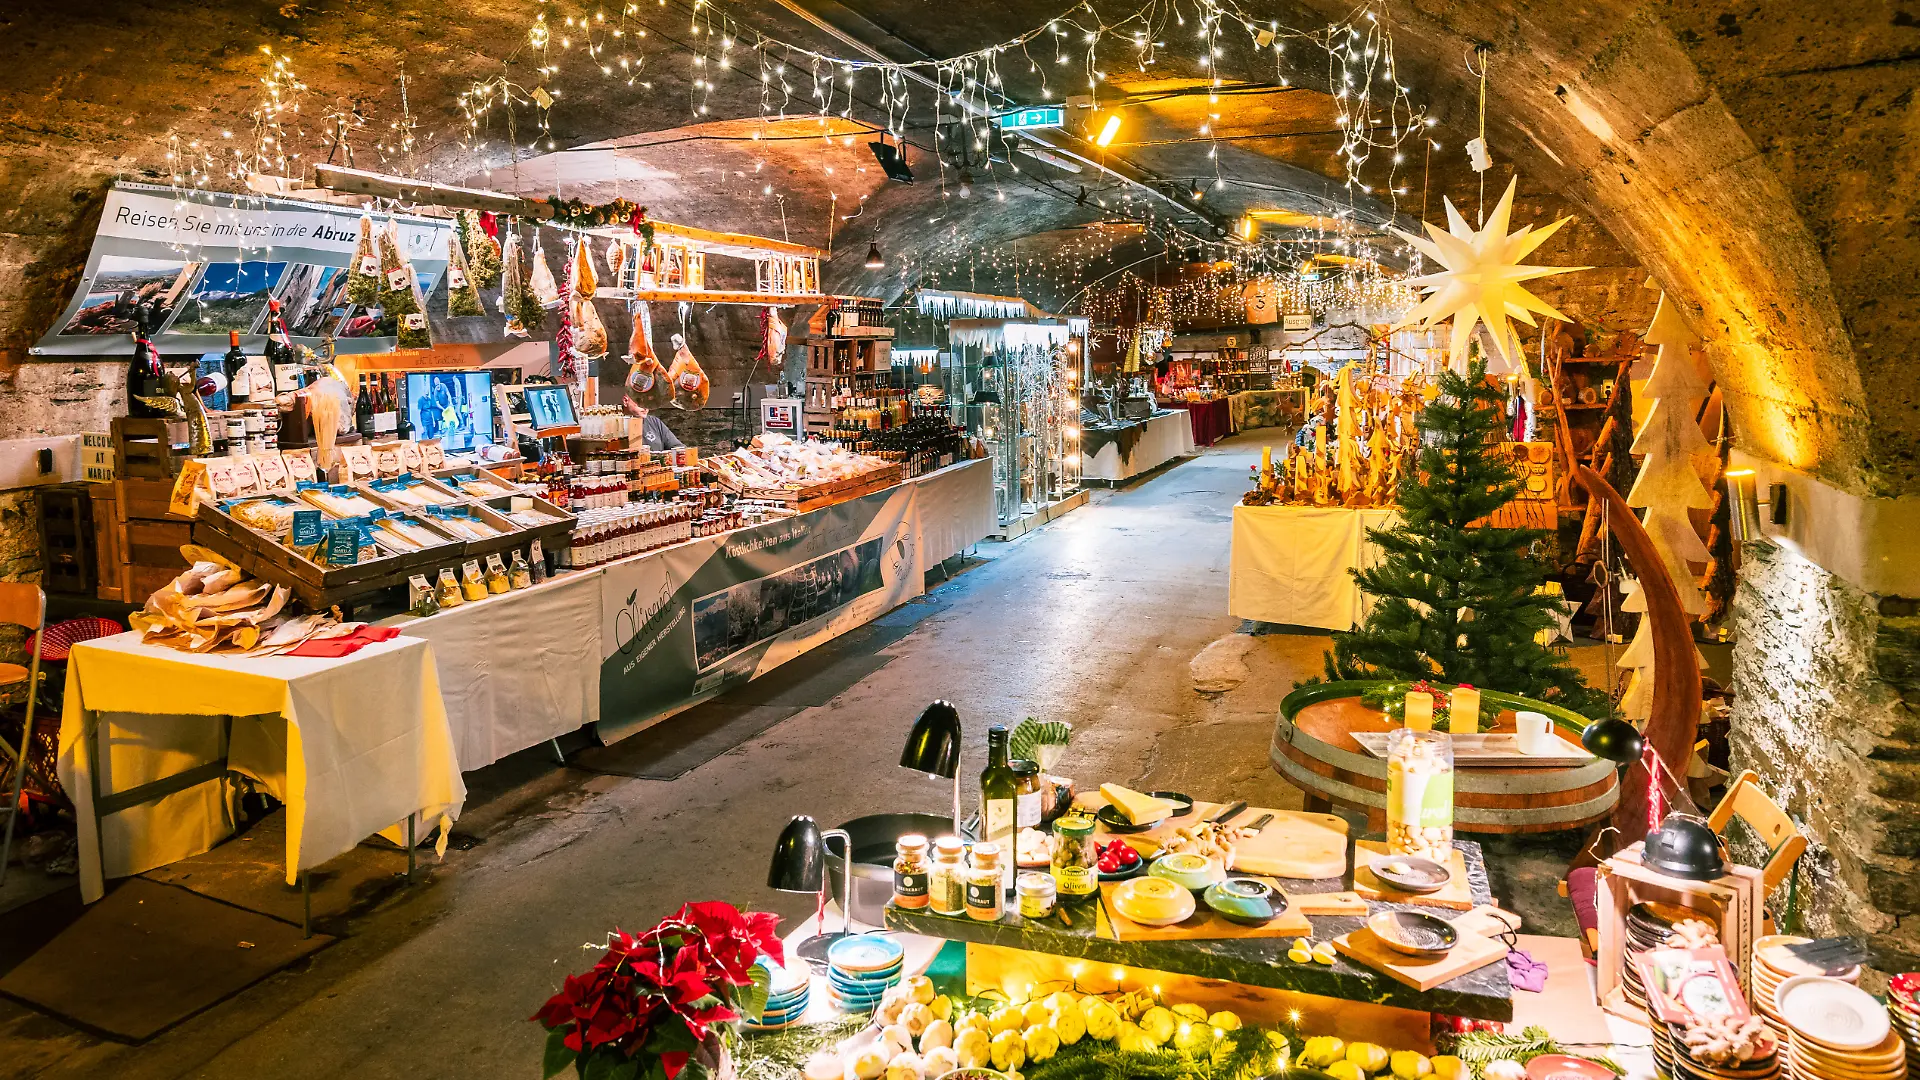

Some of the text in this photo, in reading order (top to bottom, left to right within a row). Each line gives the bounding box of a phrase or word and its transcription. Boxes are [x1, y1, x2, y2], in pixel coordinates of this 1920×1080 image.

[115, 206, 358, 243] Reisen Sie mit uns in die Abruz
[1284, 318, 1311, 326] Ausgang
[83, 435, 114, 448] WELCOM
[95, 452, 105, 464] AT
[88, 467, 114, 481] MARIO
[725, 536, 778, 559] Köstlichkeiten
[779, 532, 791, 544] aus
[623, 605, 686, 675] AUS EIGENER HERSTELLUNG
[1063, 881, 1087, 890] Oliven
